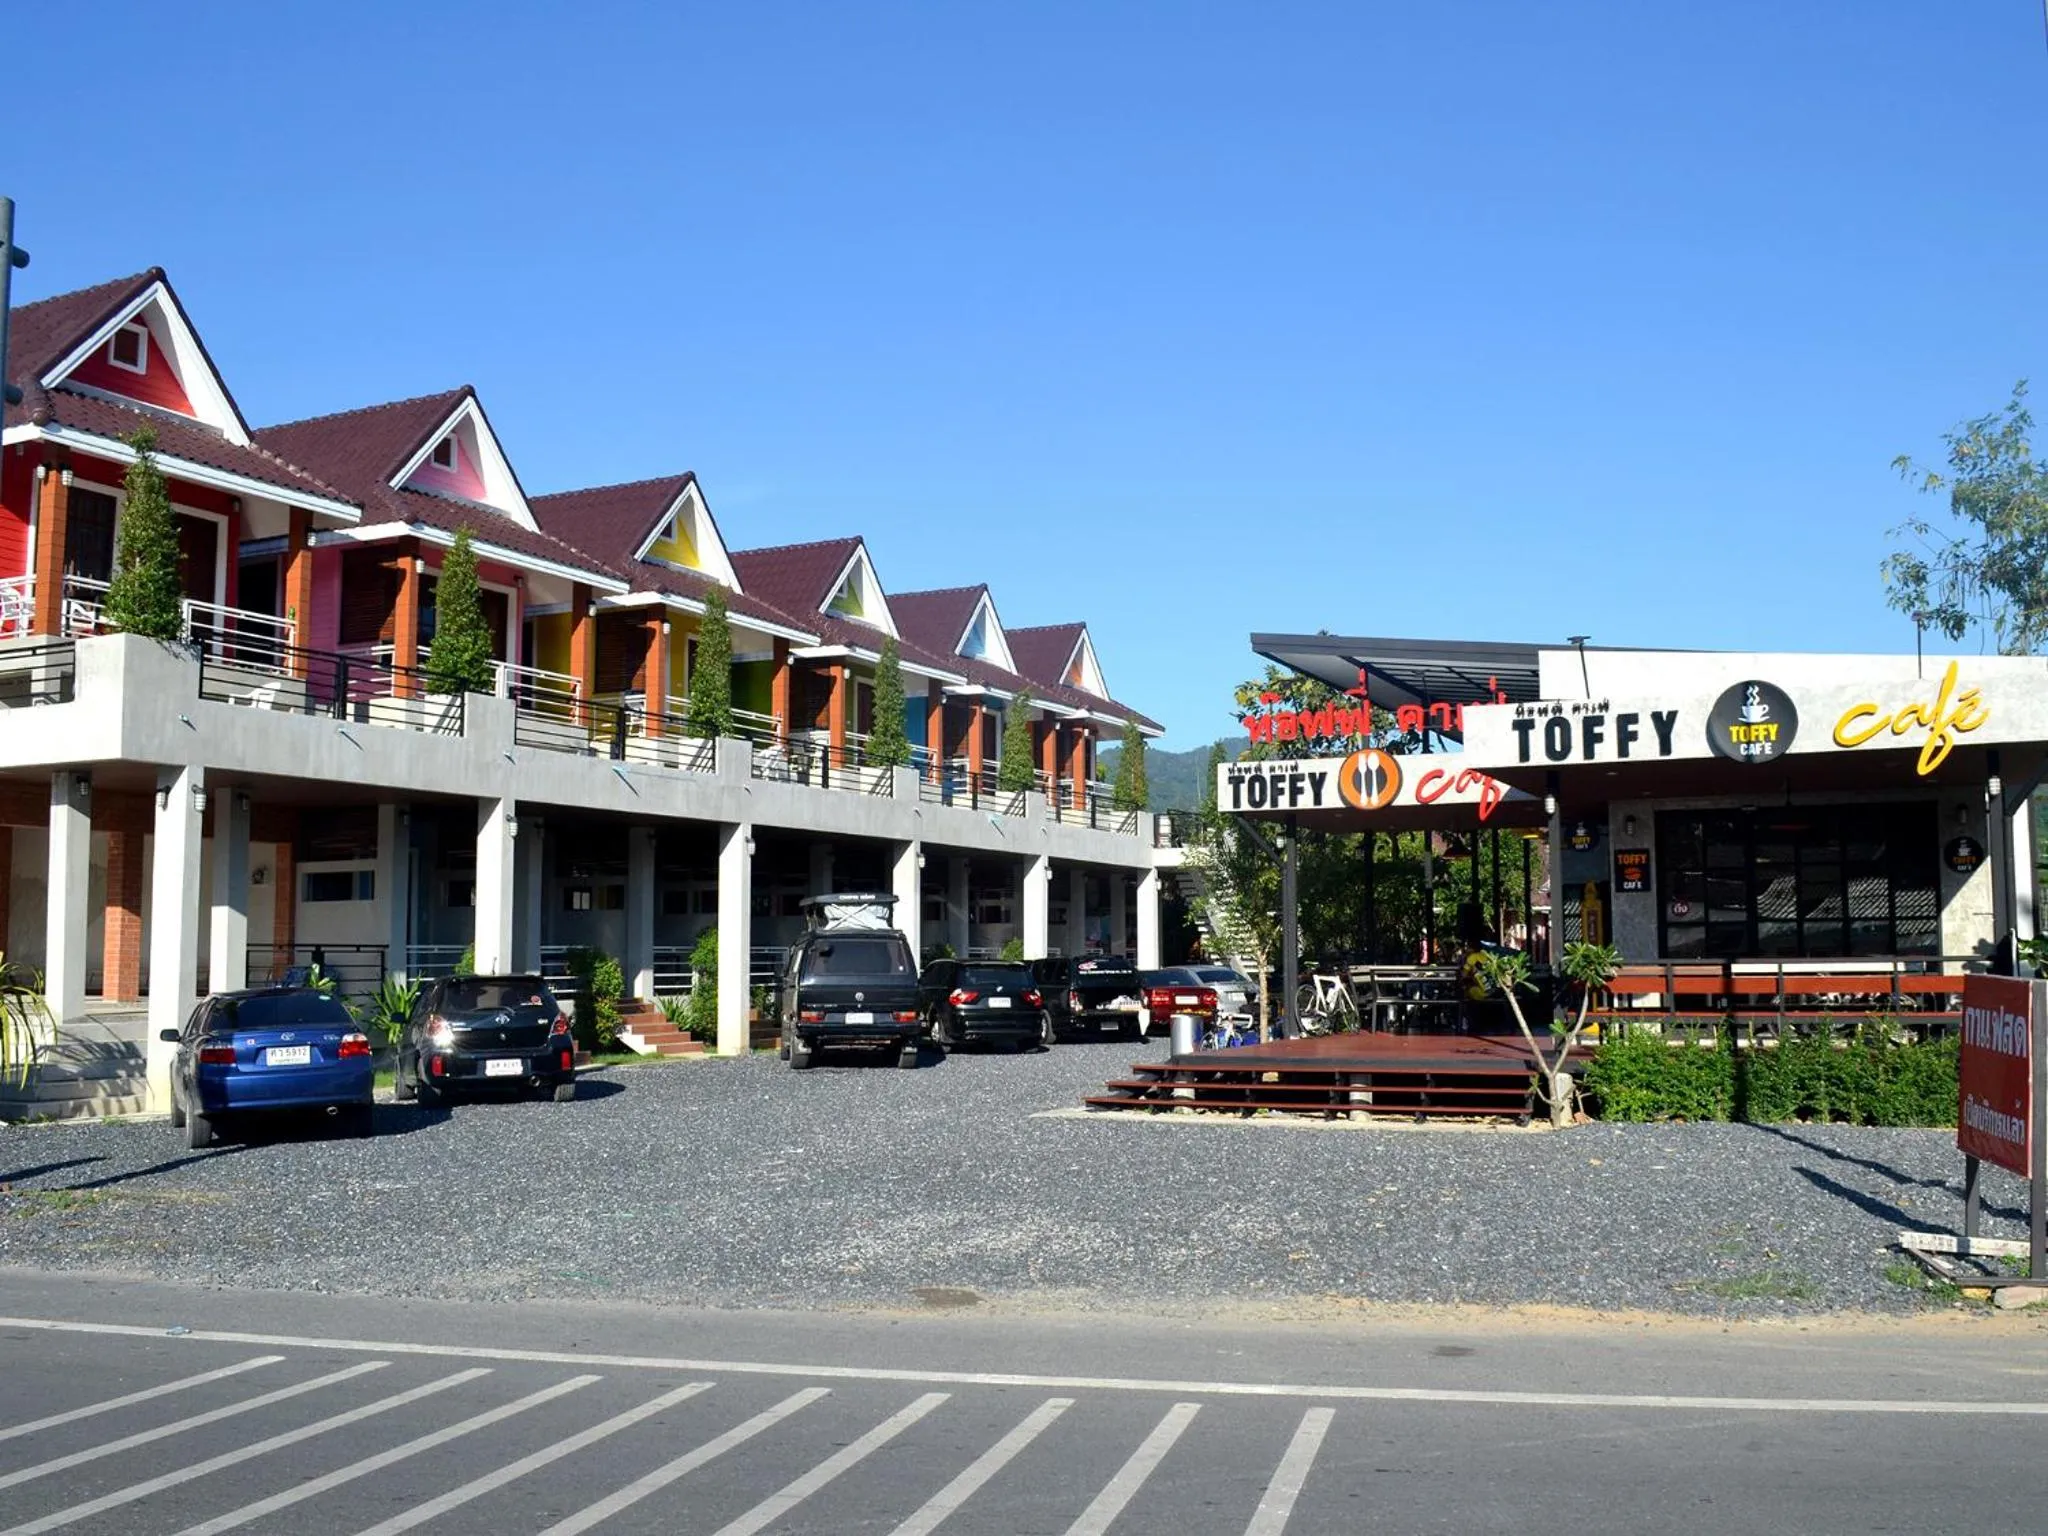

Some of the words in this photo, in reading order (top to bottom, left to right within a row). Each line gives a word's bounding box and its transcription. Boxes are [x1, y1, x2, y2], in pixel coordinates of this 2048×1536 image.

[1512, 710, 1679, 763] TOFFY
[1729, 723, 1779, 743] TOFFY
[1833, 659, 1991, 776] café
[1228, 772, 1328, 809] TOFFY
[1617, 854, 1647, 865] TOFFY
[1965, 1005, 2027, 1058] กาแฟสด
[1964, 1093, 2026, 1146] เปิดบริการแล้ว
